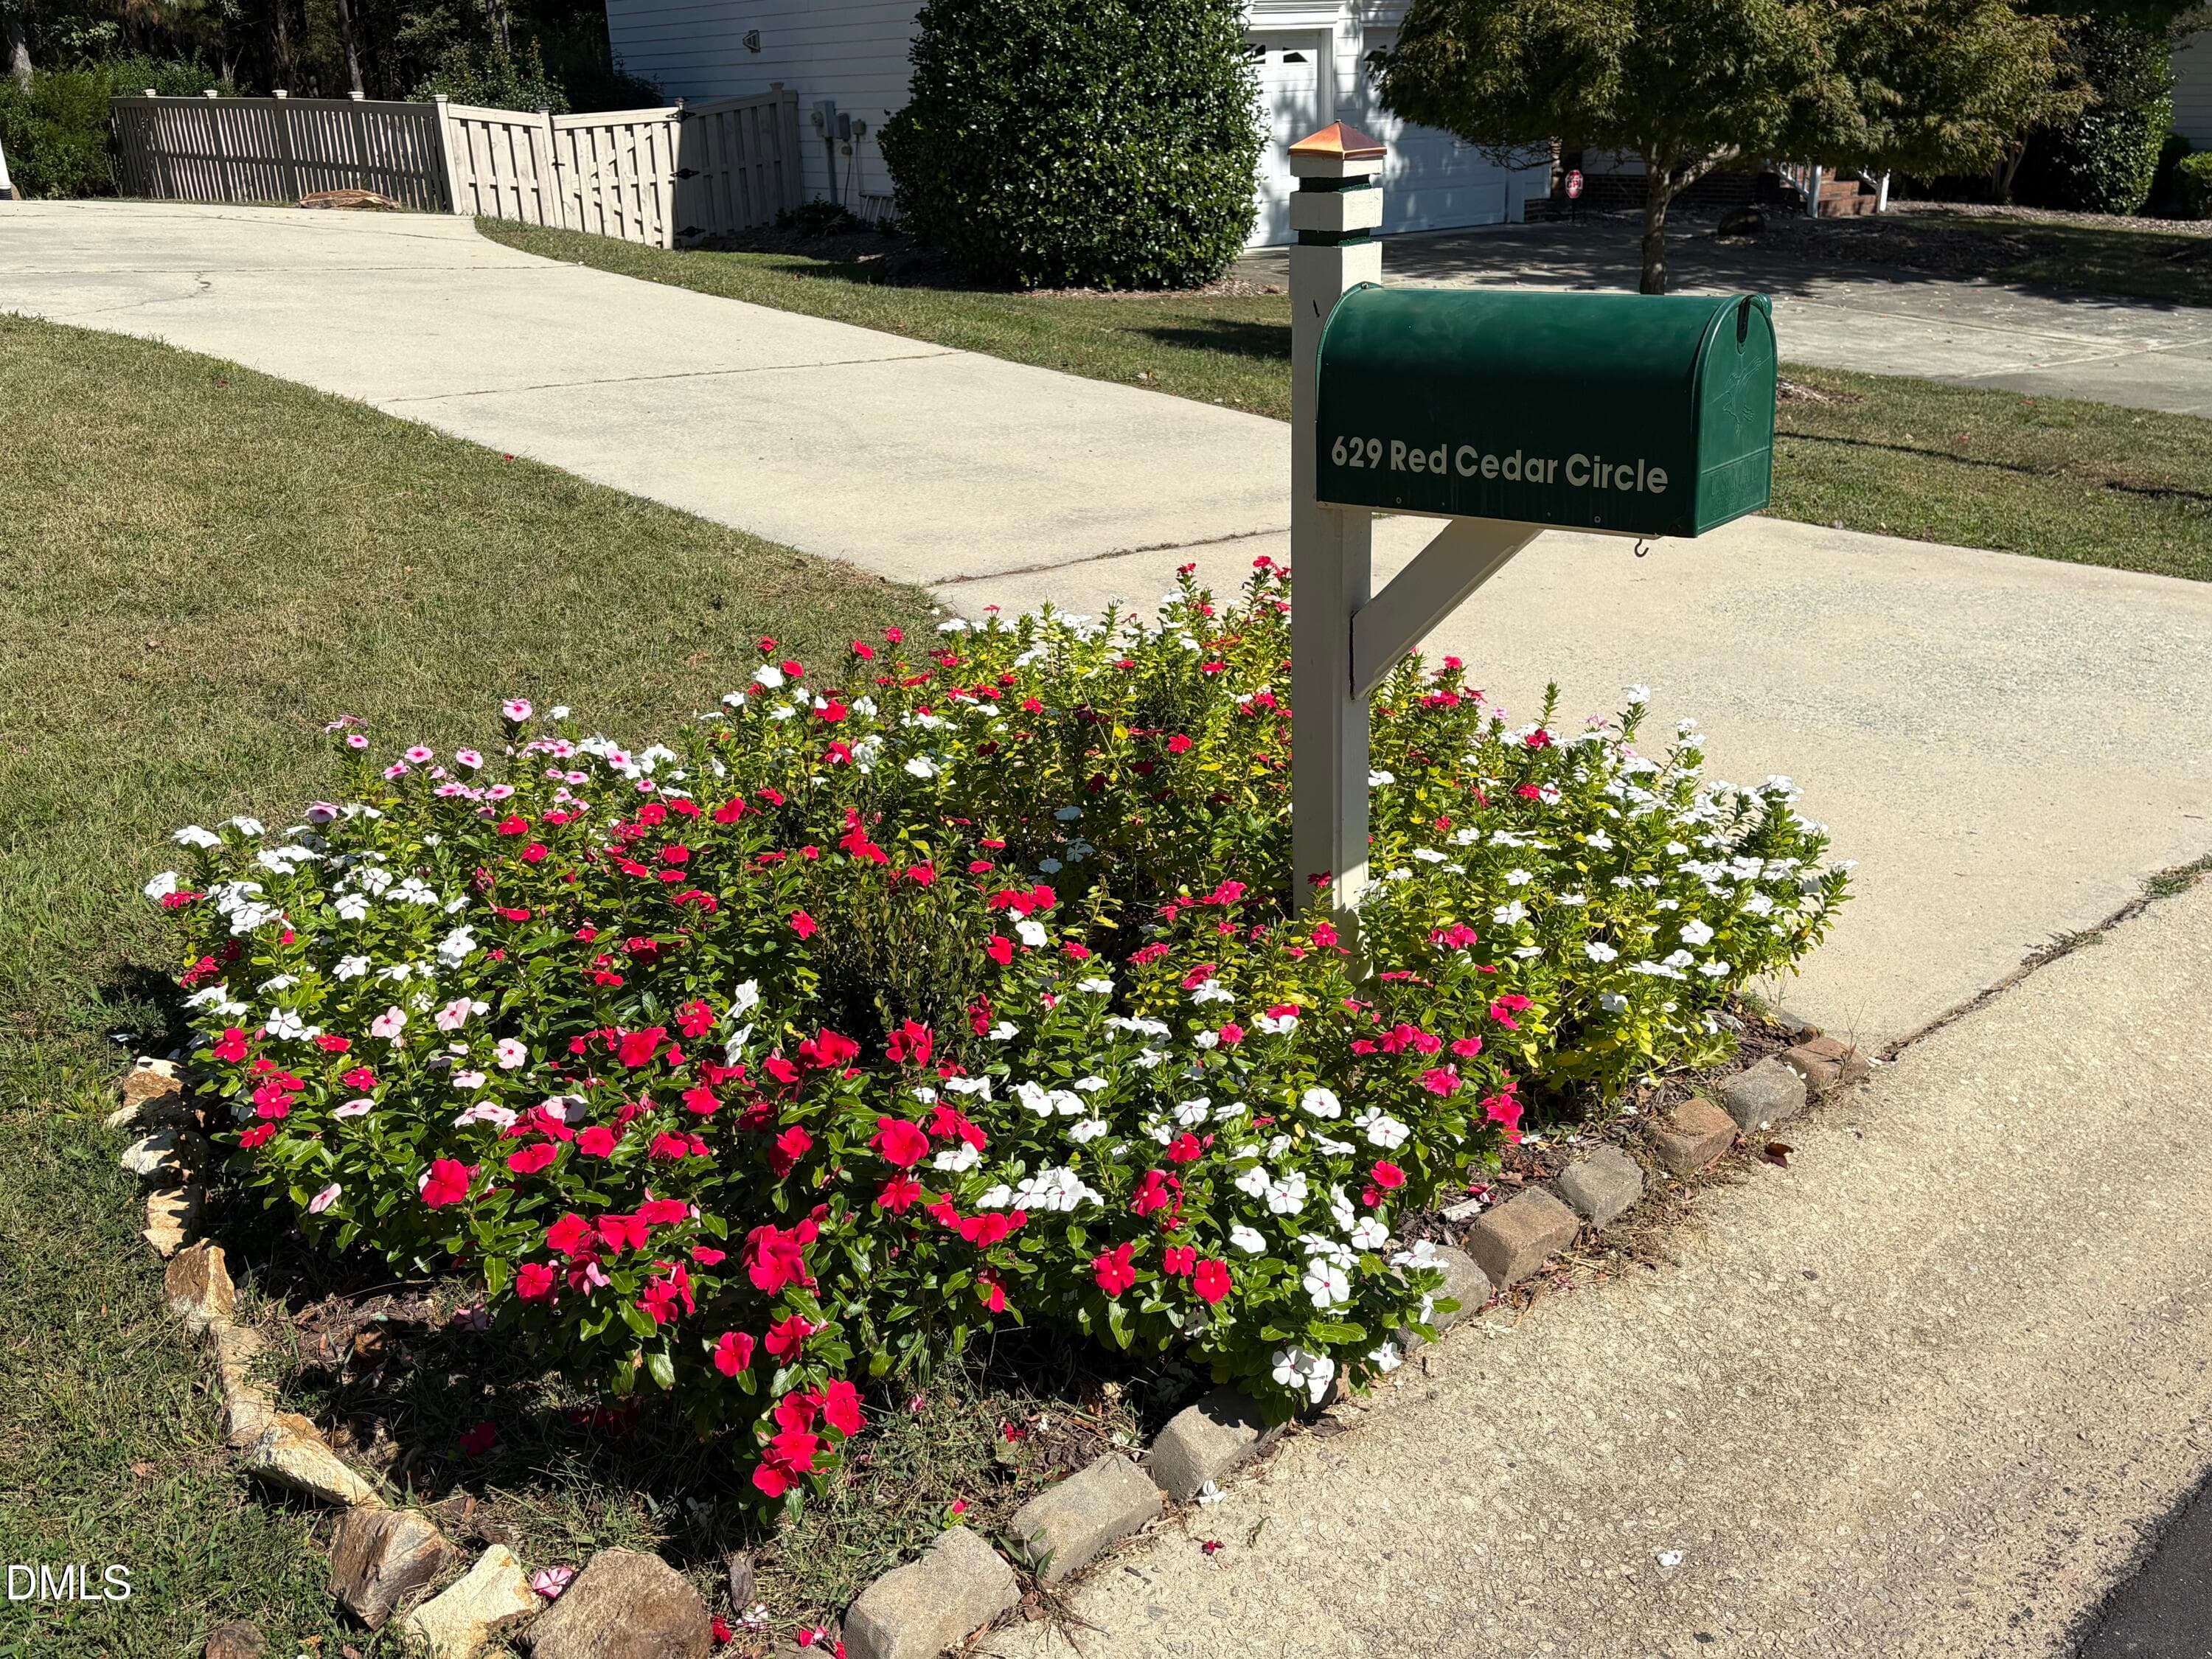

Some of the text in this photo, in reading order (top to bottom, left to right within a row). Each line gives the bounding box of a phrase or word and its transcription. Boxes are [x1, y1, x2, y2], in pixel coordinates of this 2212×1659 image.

[1567, 180, 1582, 188] CPI
[1331, 436, 1668, 493] 629 Red Cedar Circle
